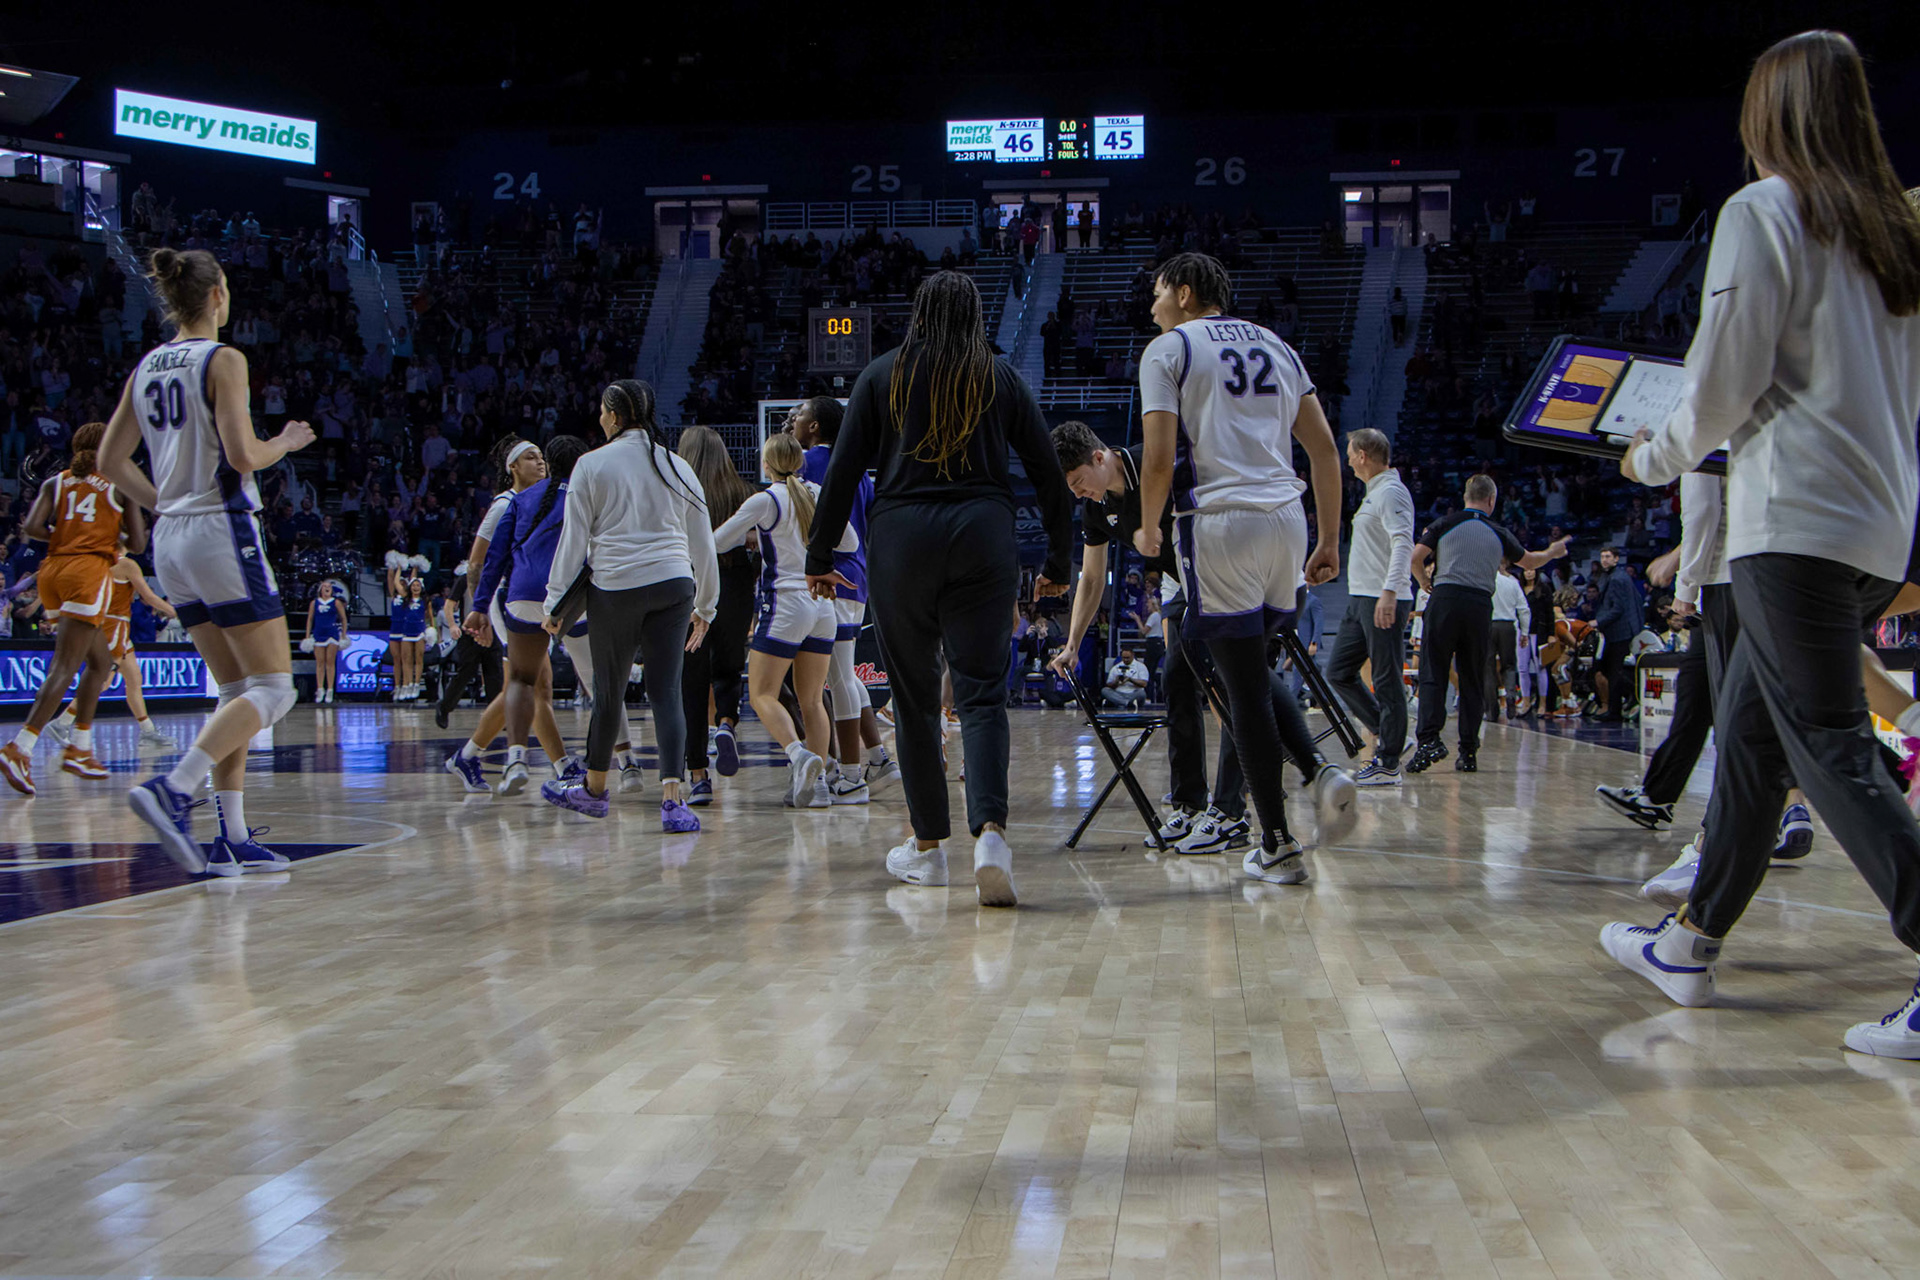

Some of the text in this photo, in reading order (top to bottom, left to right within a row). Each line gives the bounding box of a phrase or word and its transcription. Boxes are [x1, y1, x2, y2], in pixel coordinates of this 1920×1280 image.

[121, 104, 216, 139] merry
[951, 125, 993, 135] merry
[1000, 120, 1039, 128] K-STATE
[1059, 120, 1077, 133] 0.0
[1003, 133, 1034, 153] 46
[1047, 141, 1088, 150] 2 TOL 4
[1103, 130, 1133, 150] 45
[954, 151, 976, 161] 2:28
[976, 151, 992, 160] PM
[1047, 151, 1053, 159] 2
[1058, 150, 1079, 159] FOULS
[1082, 150, 1088, 159] 4
[1574, 147, 1626, 177] 27
[851, 164, 901, 193] 25
[1194, 156, 1247, 186] 26
[493, 171, 542, 200] 24
[1219, 347, 1280, 398] 32
[144, 378, 188, 432] 30
[65, 490, 98, 523] 14
